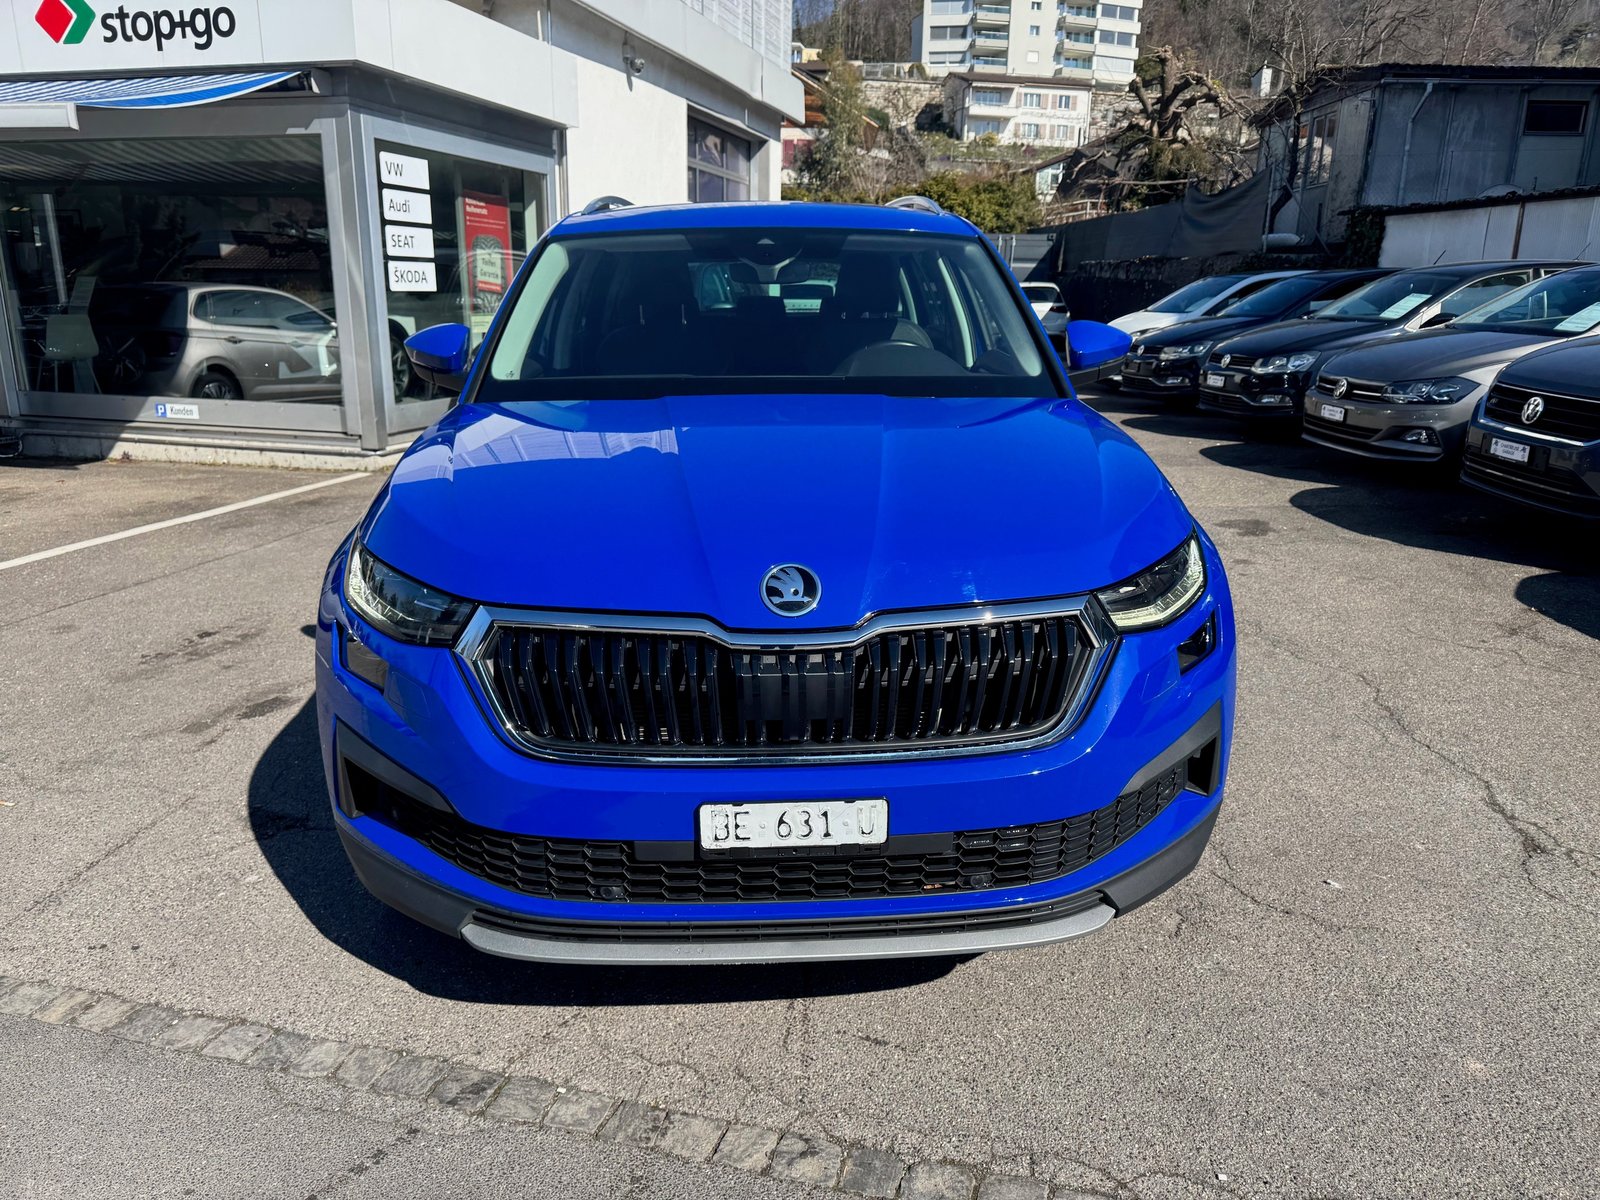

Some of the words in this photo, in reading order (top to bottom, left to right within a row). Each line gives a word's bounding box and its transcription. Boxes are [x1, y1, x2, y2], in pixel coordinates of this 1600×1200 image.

[100, 5, 236, 51] stop+go
[385, 161, 403, 177] VW
[389, 198, 411, 213] Audi
[391, 234, 415, 249] SEAT
[394, 266, 428, 283] ŠKODA
[170, 406, 194, 416] Kunden
[776, 809, 833, 839] 631
